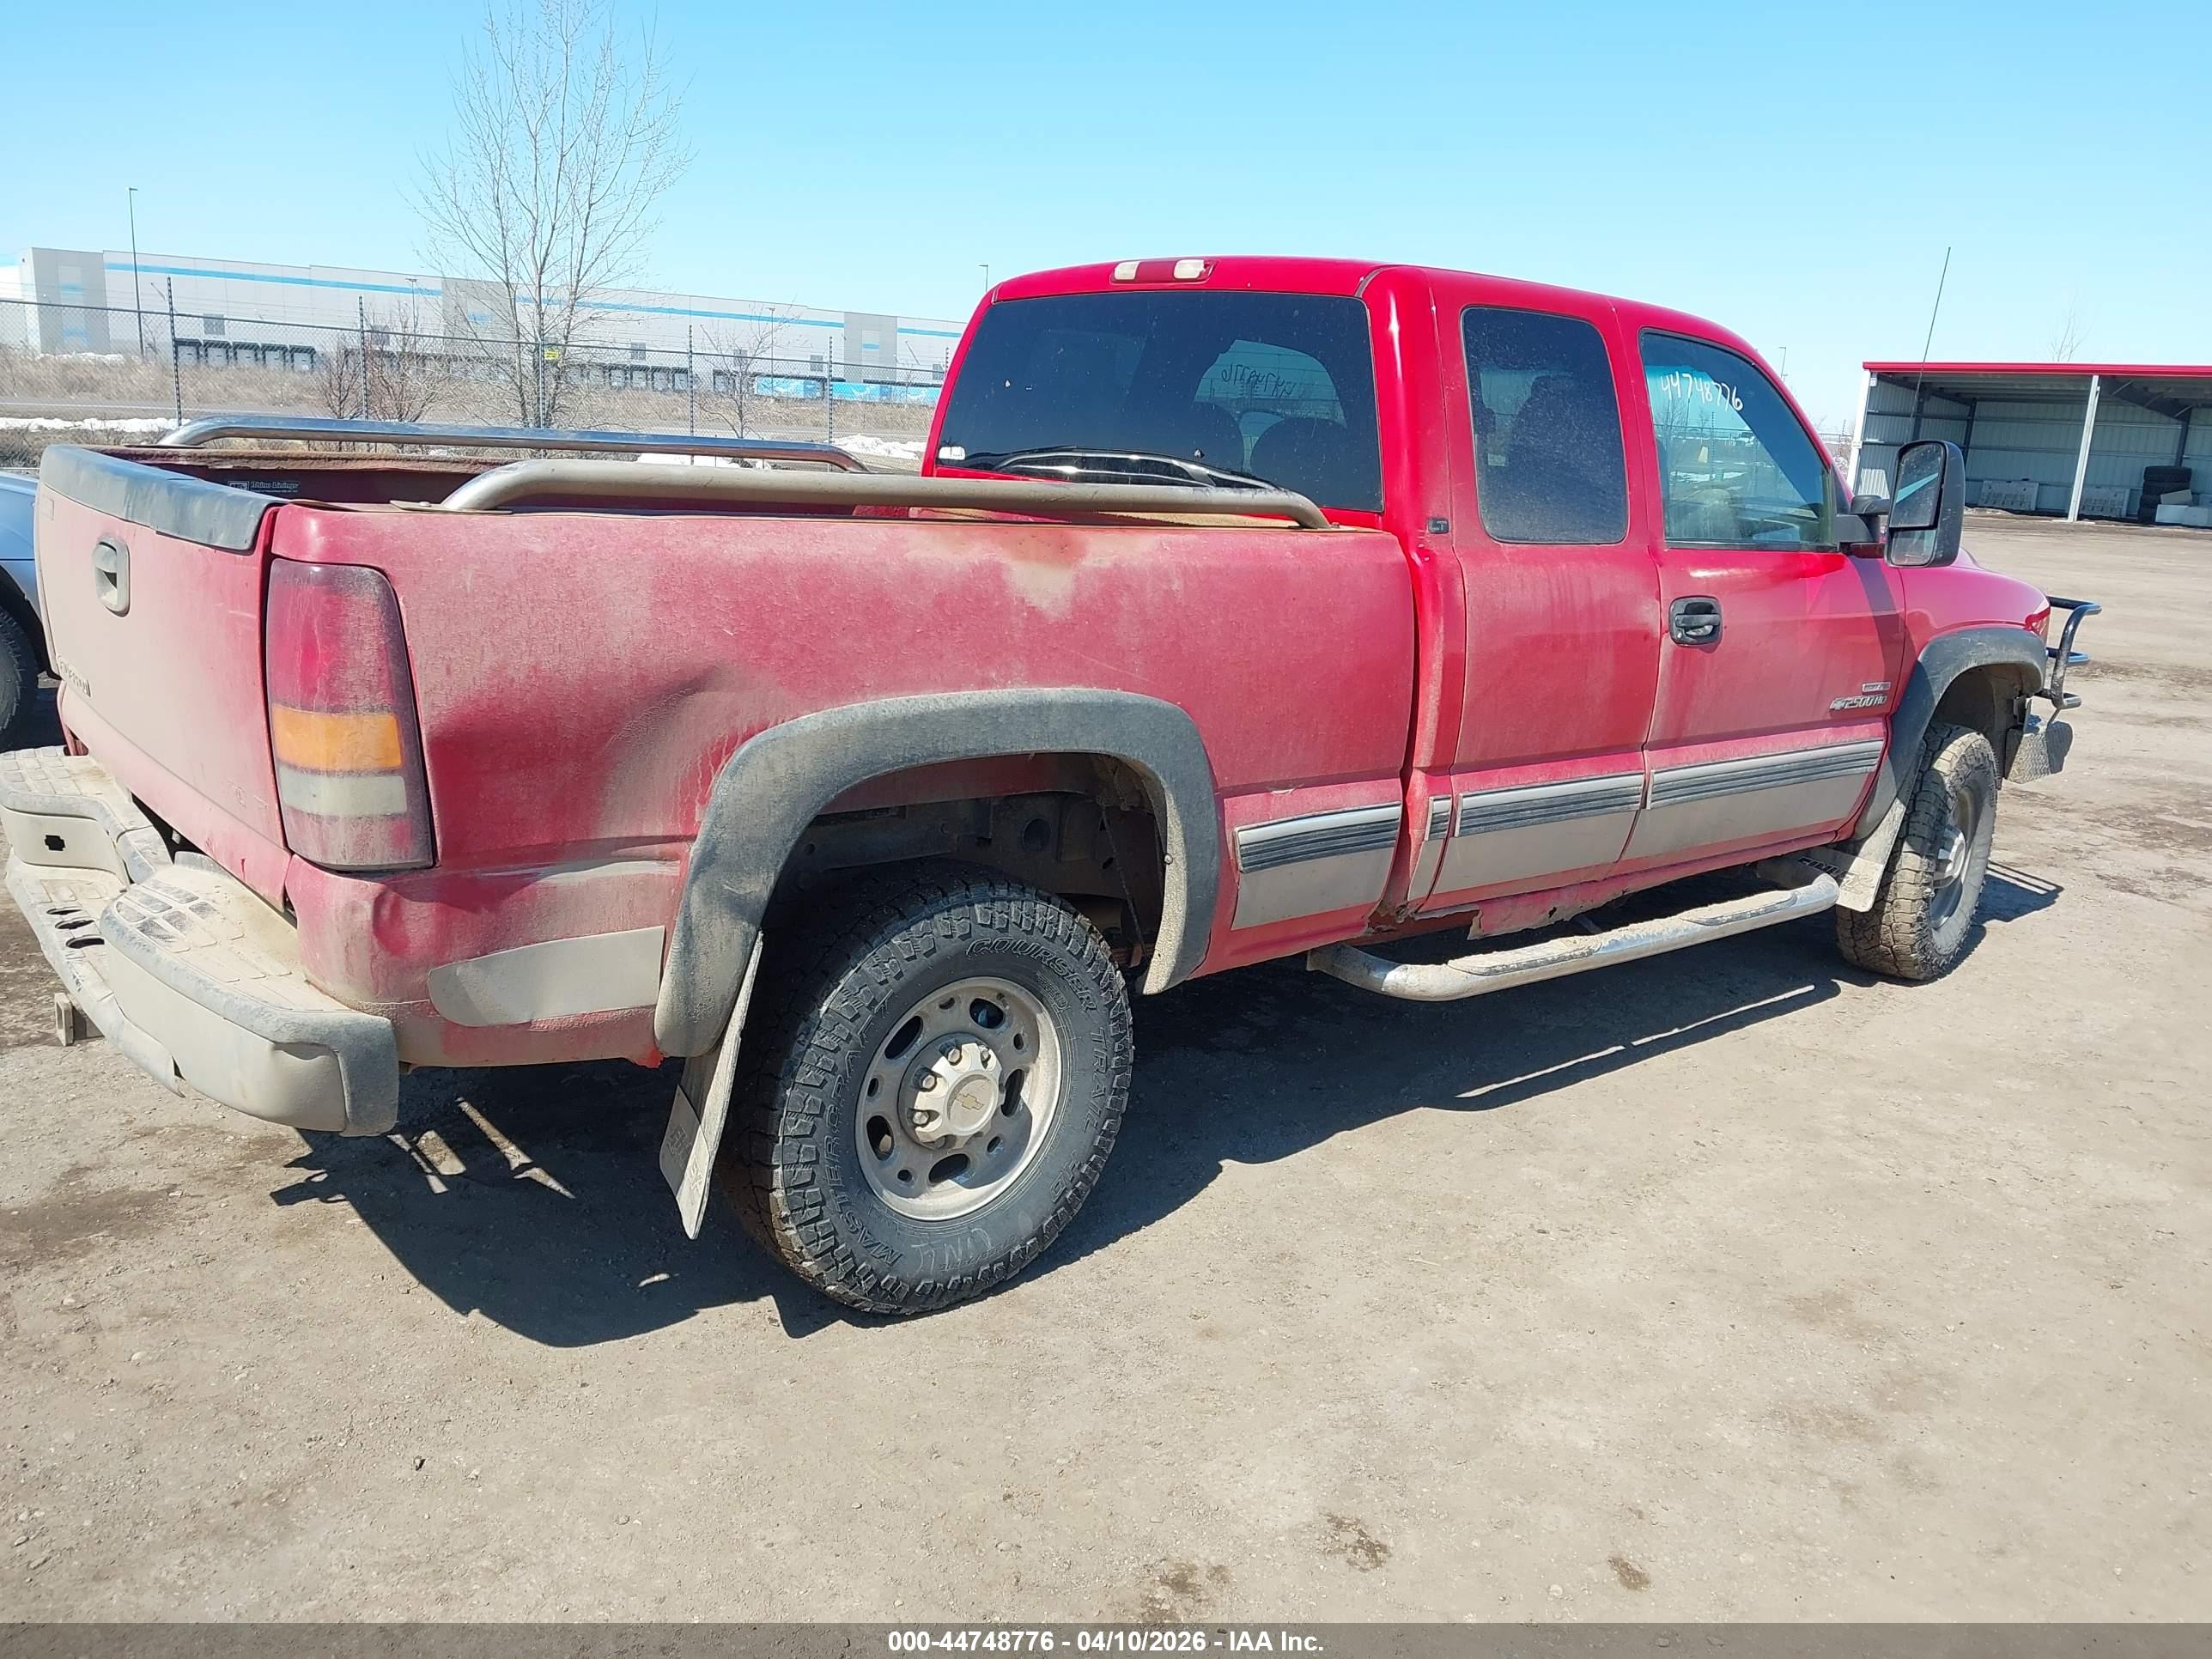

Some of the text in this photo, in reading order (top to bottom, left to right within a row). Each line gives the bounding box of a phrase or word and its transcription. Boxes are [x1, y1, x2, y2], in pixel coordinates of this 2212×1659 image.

[1660, 371, 1744, 412] 44748776
[965, 936, 1098, 1012] COURSER
[1083, 1026, 1109, 1134] TRAIL
